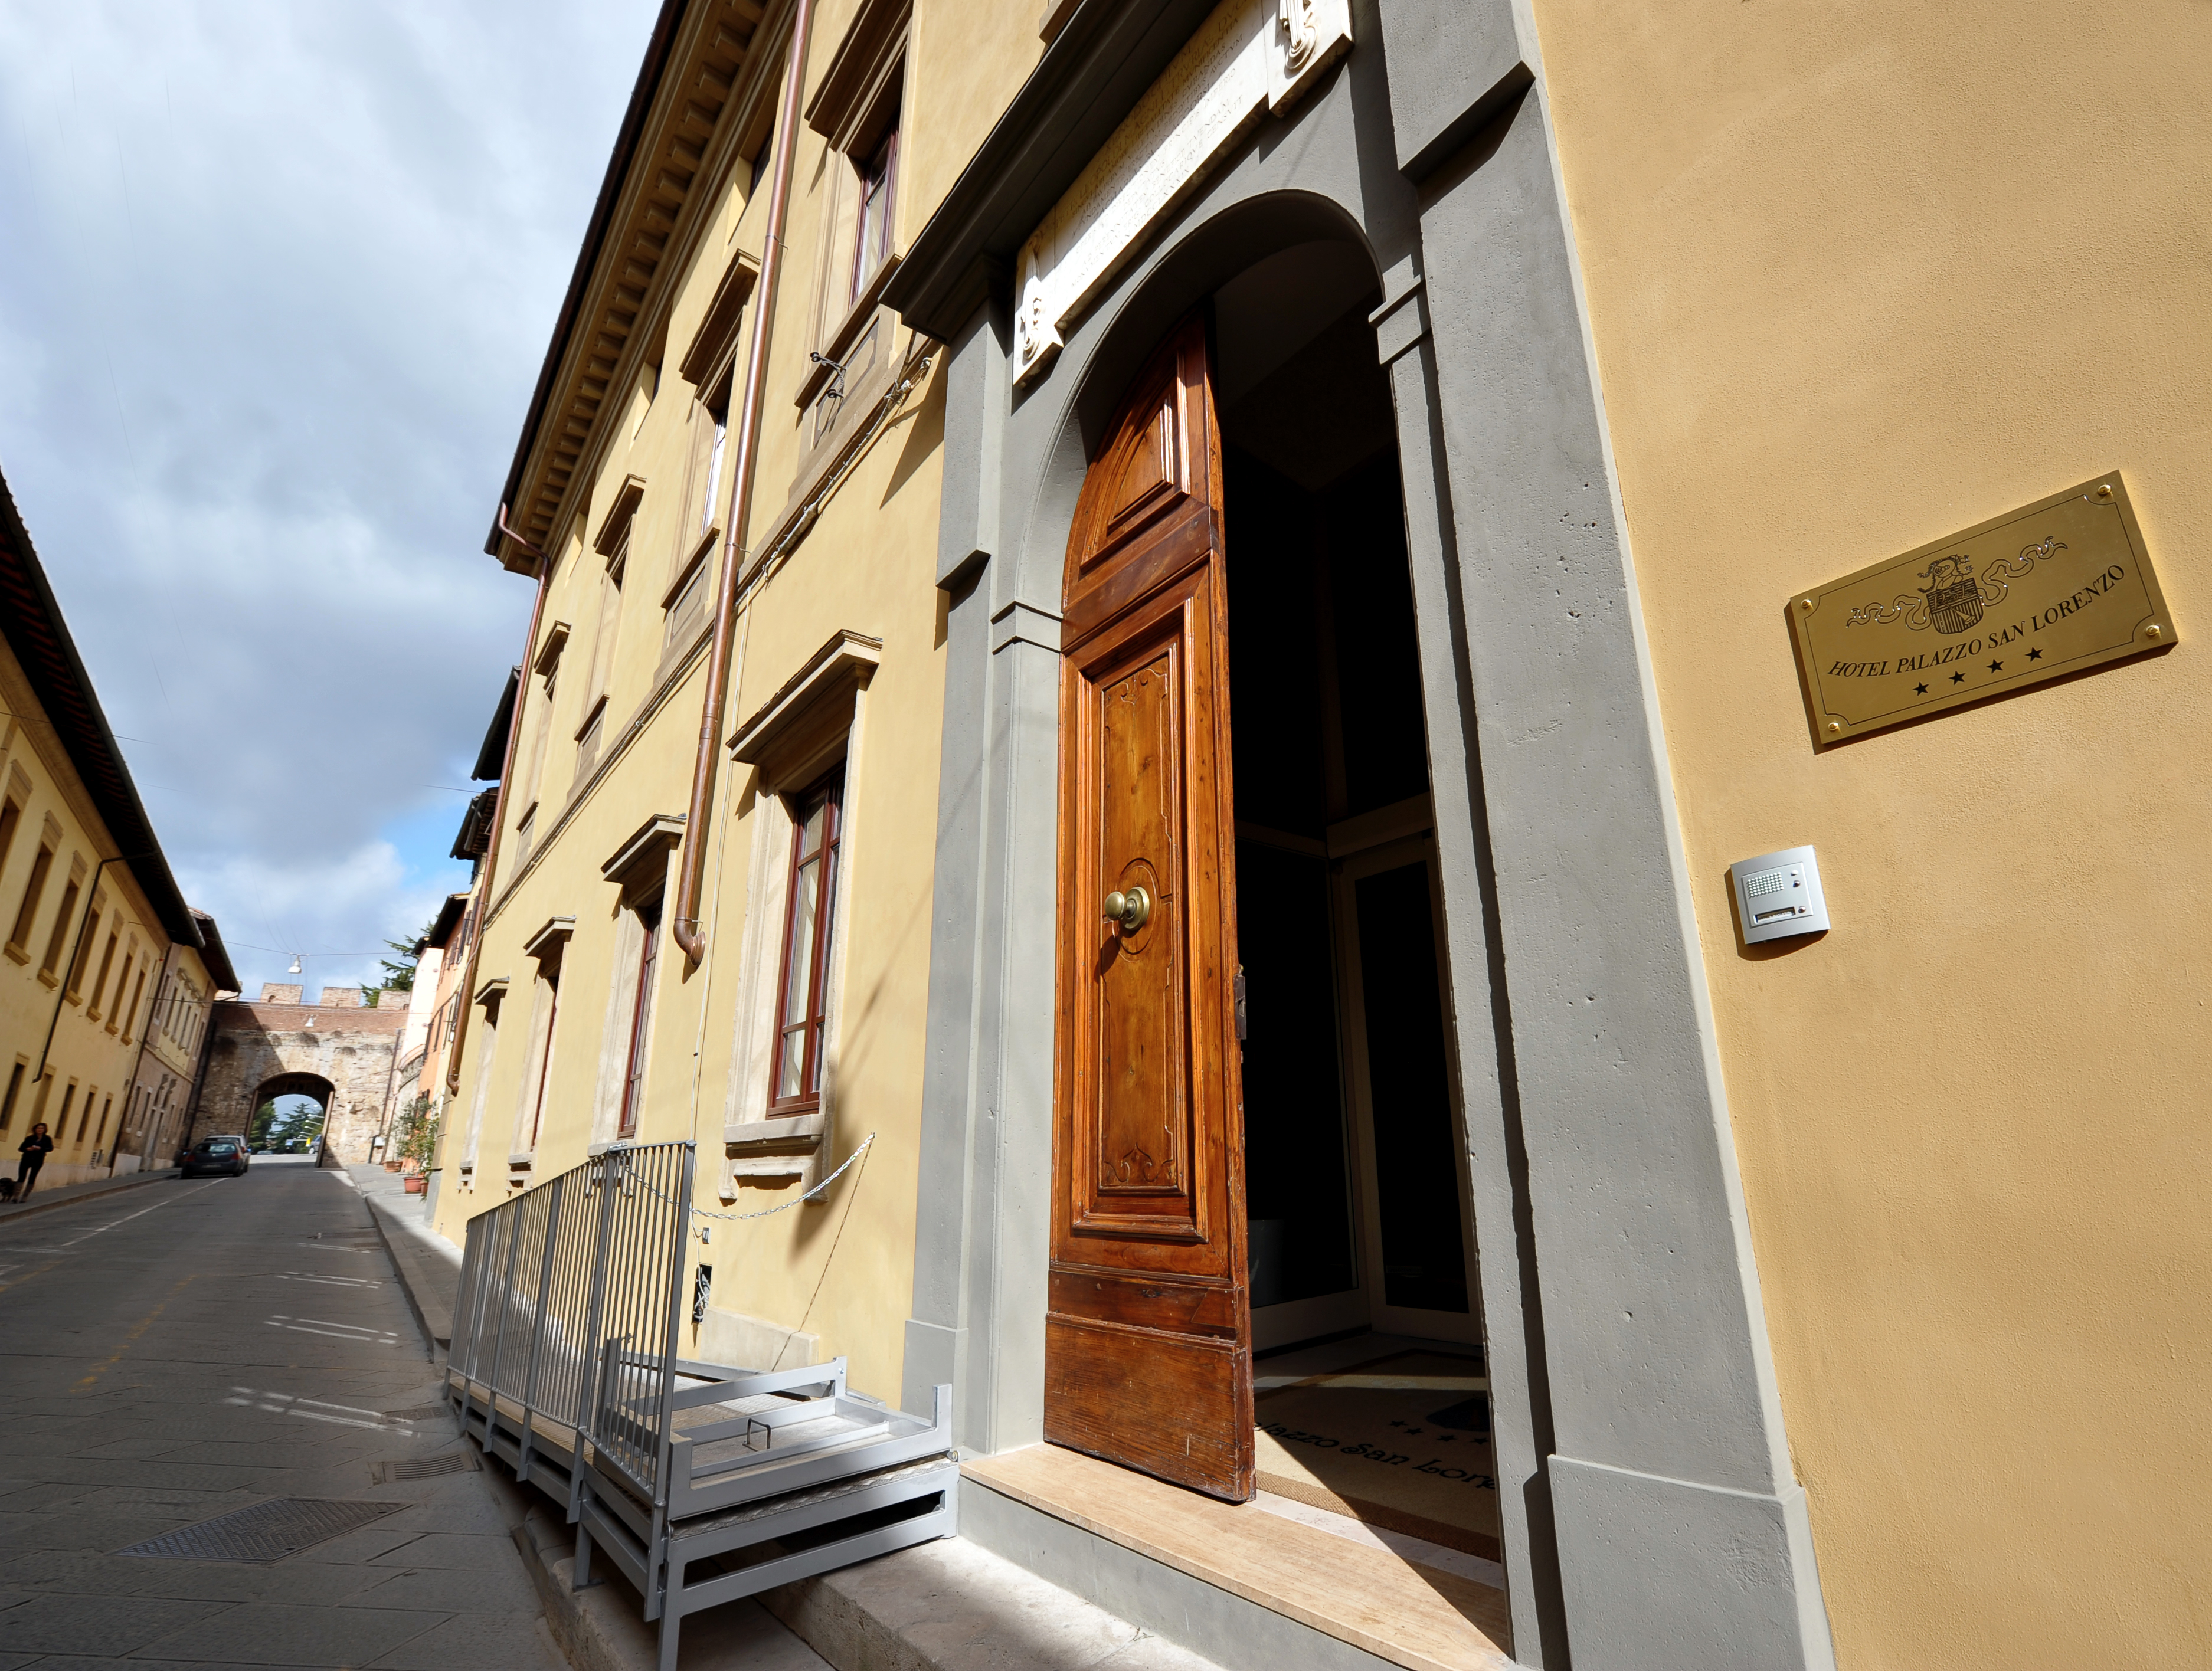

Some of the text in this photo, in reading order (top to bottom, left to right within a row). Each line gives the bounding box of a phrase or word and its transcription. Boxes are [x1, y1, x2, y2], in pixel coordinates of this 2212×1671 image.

[1183, 15, 1238, 87] MVNIFICENTIA
[1209, 32, 1242, 77] AVCTVM
[1127, 97, 1177, 163] VALETVDINES
[1182, 41, 1225, 99] CVRANDAS
[1204, 65, 1235, 109] IMPERIO
[1125, 97, 1157, 146] MAGNI
[1187, 96, 1229, 150] TVENDAM
[1144, 137, 1203, 209] COLLOCARIQVE
[1206, 91, 1243, 140] CENSVIT
[1827, 564, 2125, 677] HOTEL PALAZZO SAN LORENZO
[1341, 1443, 1410, 1466] San
